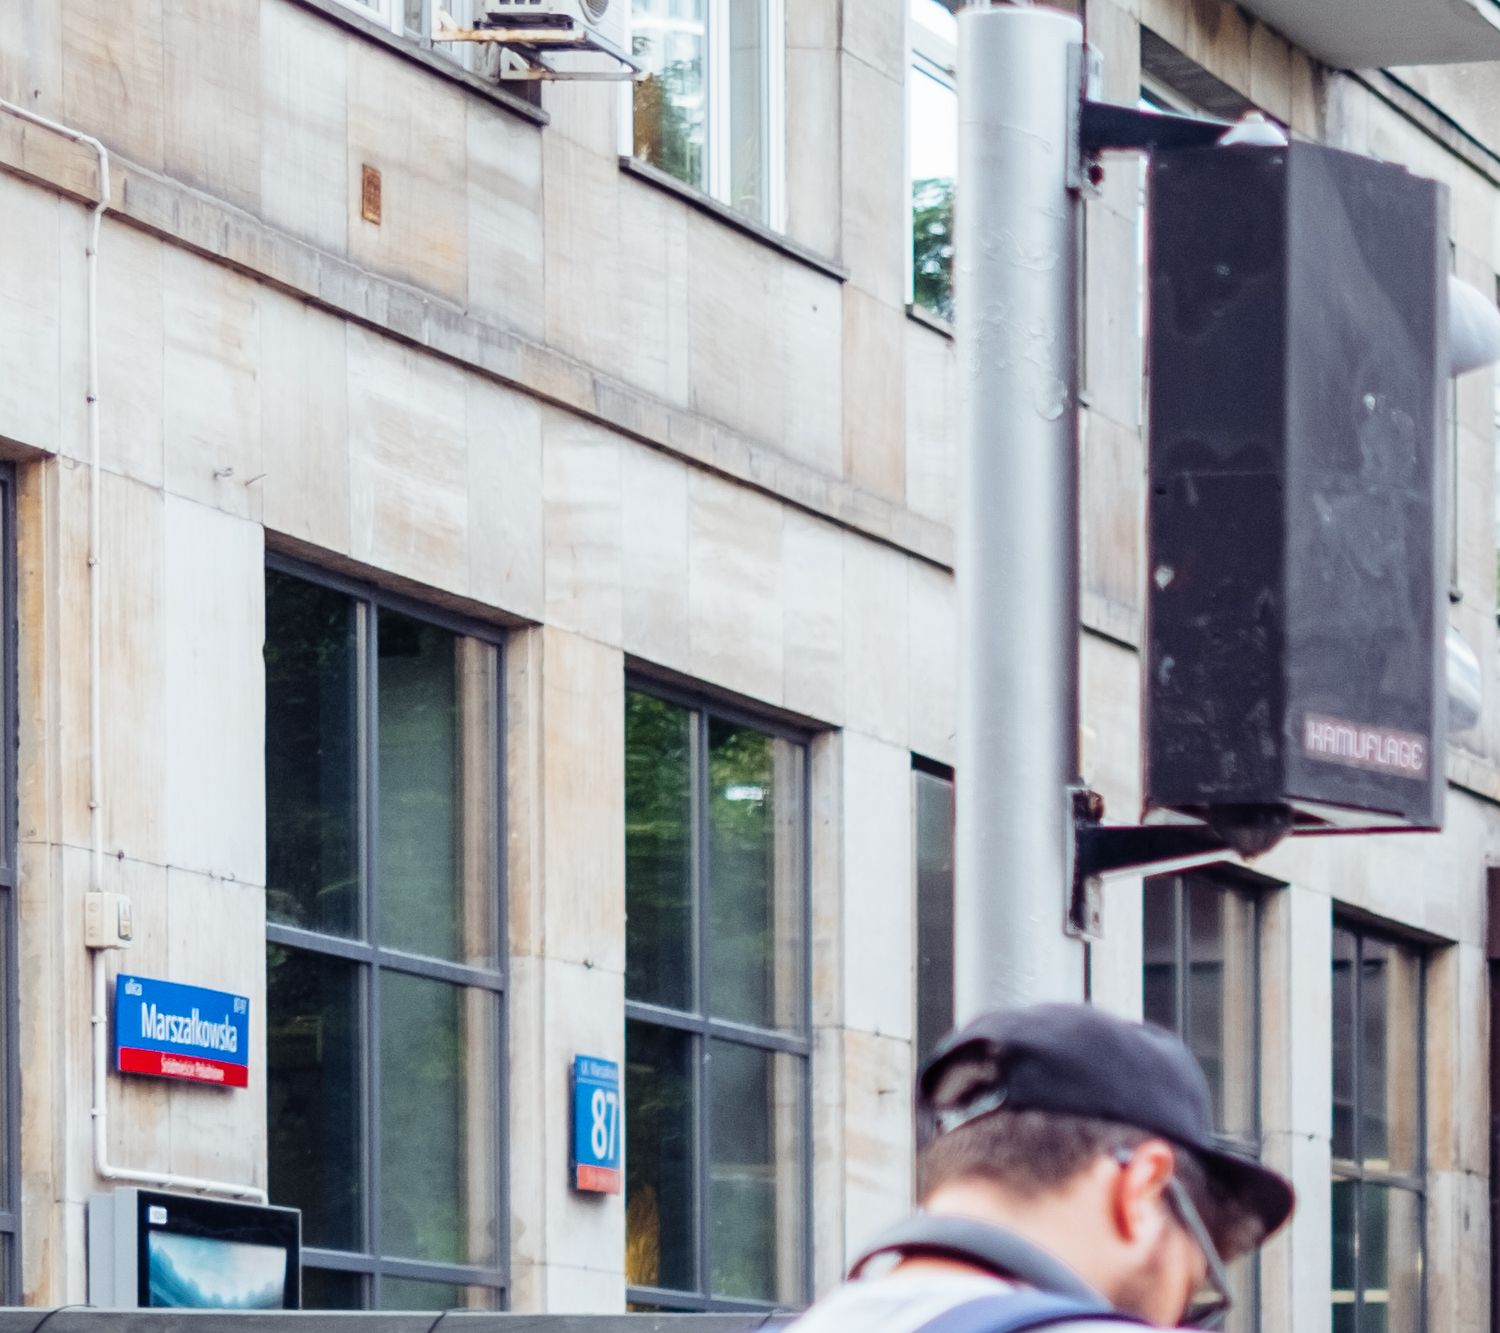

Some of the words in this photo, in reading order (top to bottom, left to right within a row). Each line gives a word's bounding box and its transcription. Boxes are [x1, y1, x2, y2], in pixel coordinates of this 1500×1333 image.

[1306, 719, 1424, 771] KAMUFLAGE
[141, 1001, 238, 1053] Marszałkowska
[591, 1088, 618, 1161] 87
